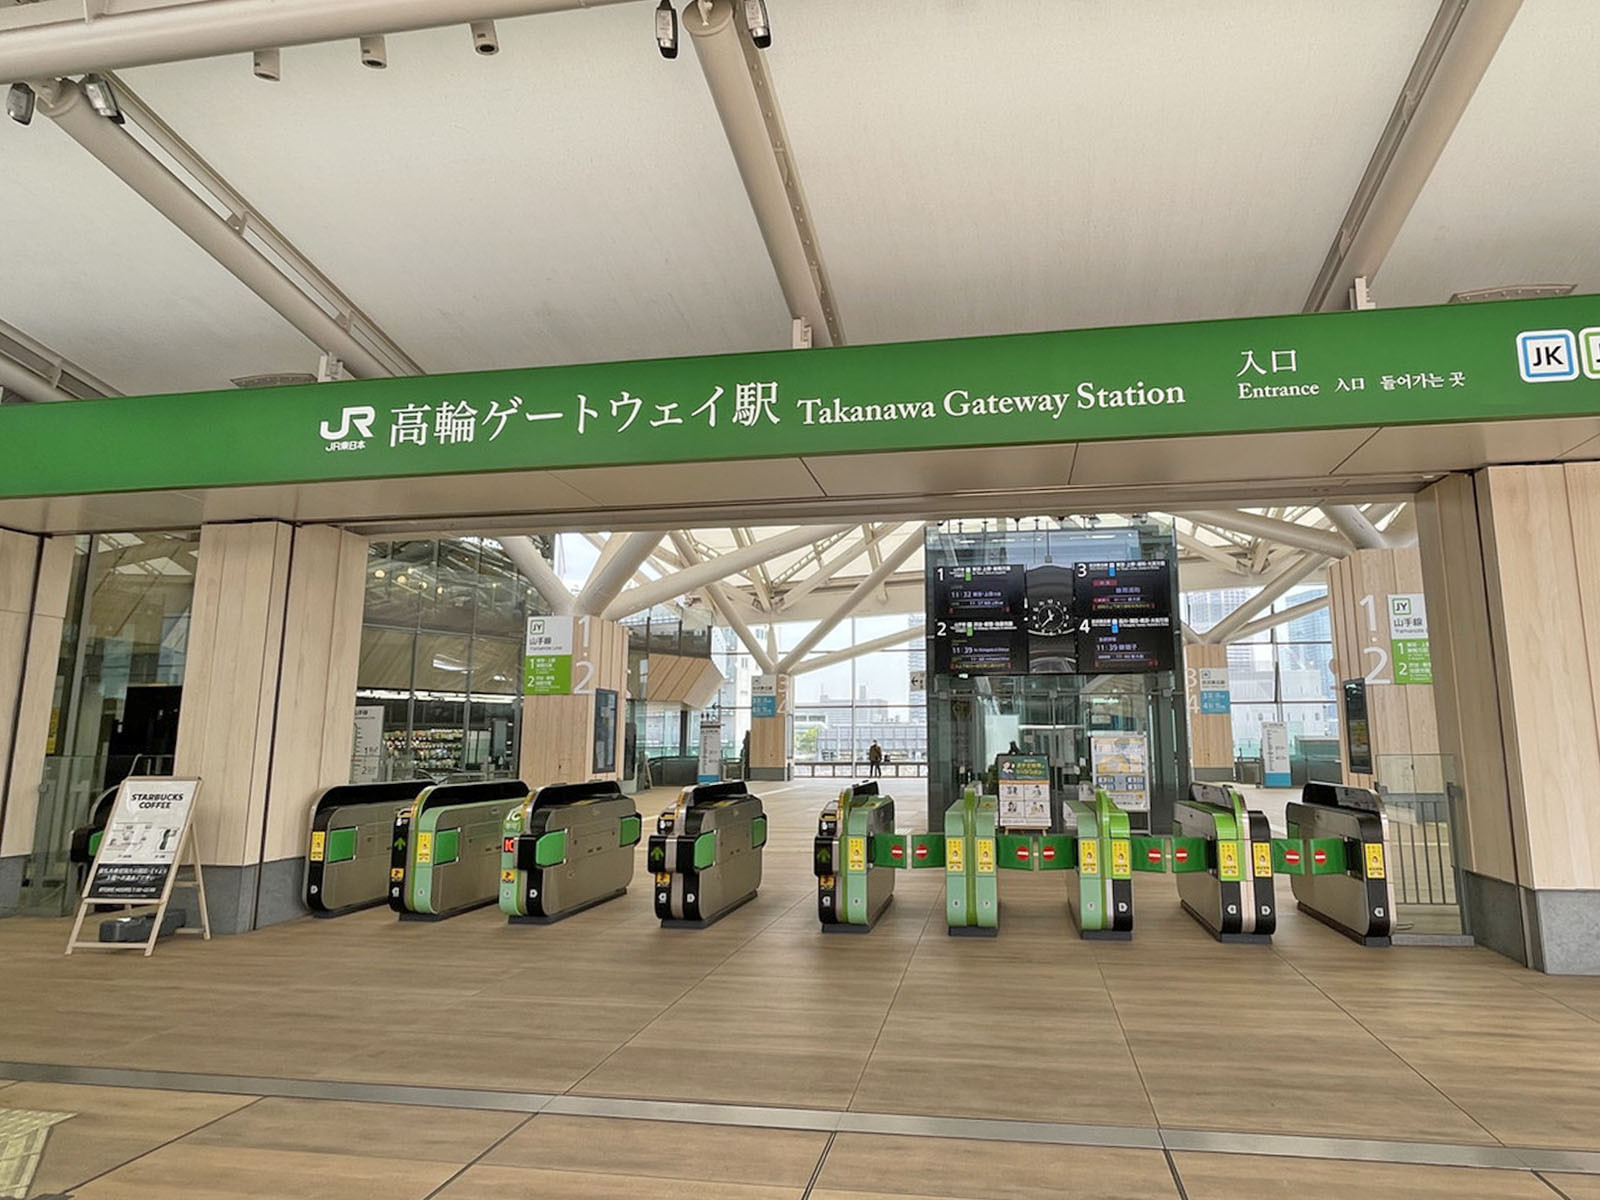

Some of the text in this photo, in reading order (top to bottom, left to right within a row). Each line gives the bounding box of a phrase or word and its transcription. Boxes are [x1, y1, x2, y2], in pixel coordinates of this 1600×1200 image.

[1237, 350, 1296, 376] 入口
[1533, 345, 1564, 367] JK
[1335, 377, 1365, 392] 入口
[1380, 371, 1466, 391] 들어가는 곳
[1237, 383, 1320, 399] Entrance
[797, 381, 1186, 425] Takanawa Gateway Station
[389, 381, 781, 447] 高輪ゲートウェイ駅
[320, 405, 375, 440] JR
[325, 440, 366, 452] JR東日本
[937, 567, 944, 581] 1
[1077, 562, 1088, 577] 3
[1360, 595, 1376, 631] 1
[1396, 602, 1407, 611] JY
[578, 616, 590, 647] 1
[936, 621, 947, 636] 2
[1079, 618, 1091, 634] 4
[1398, 642, 1405, 655] 1
[530, 659, 535, 669] 1
[1362, 646, 1391, 685] 2
[1399, 663, 1408, 675] 2
[528, 676, 535, 687] 2
[574, 660, 596, 694] 2
